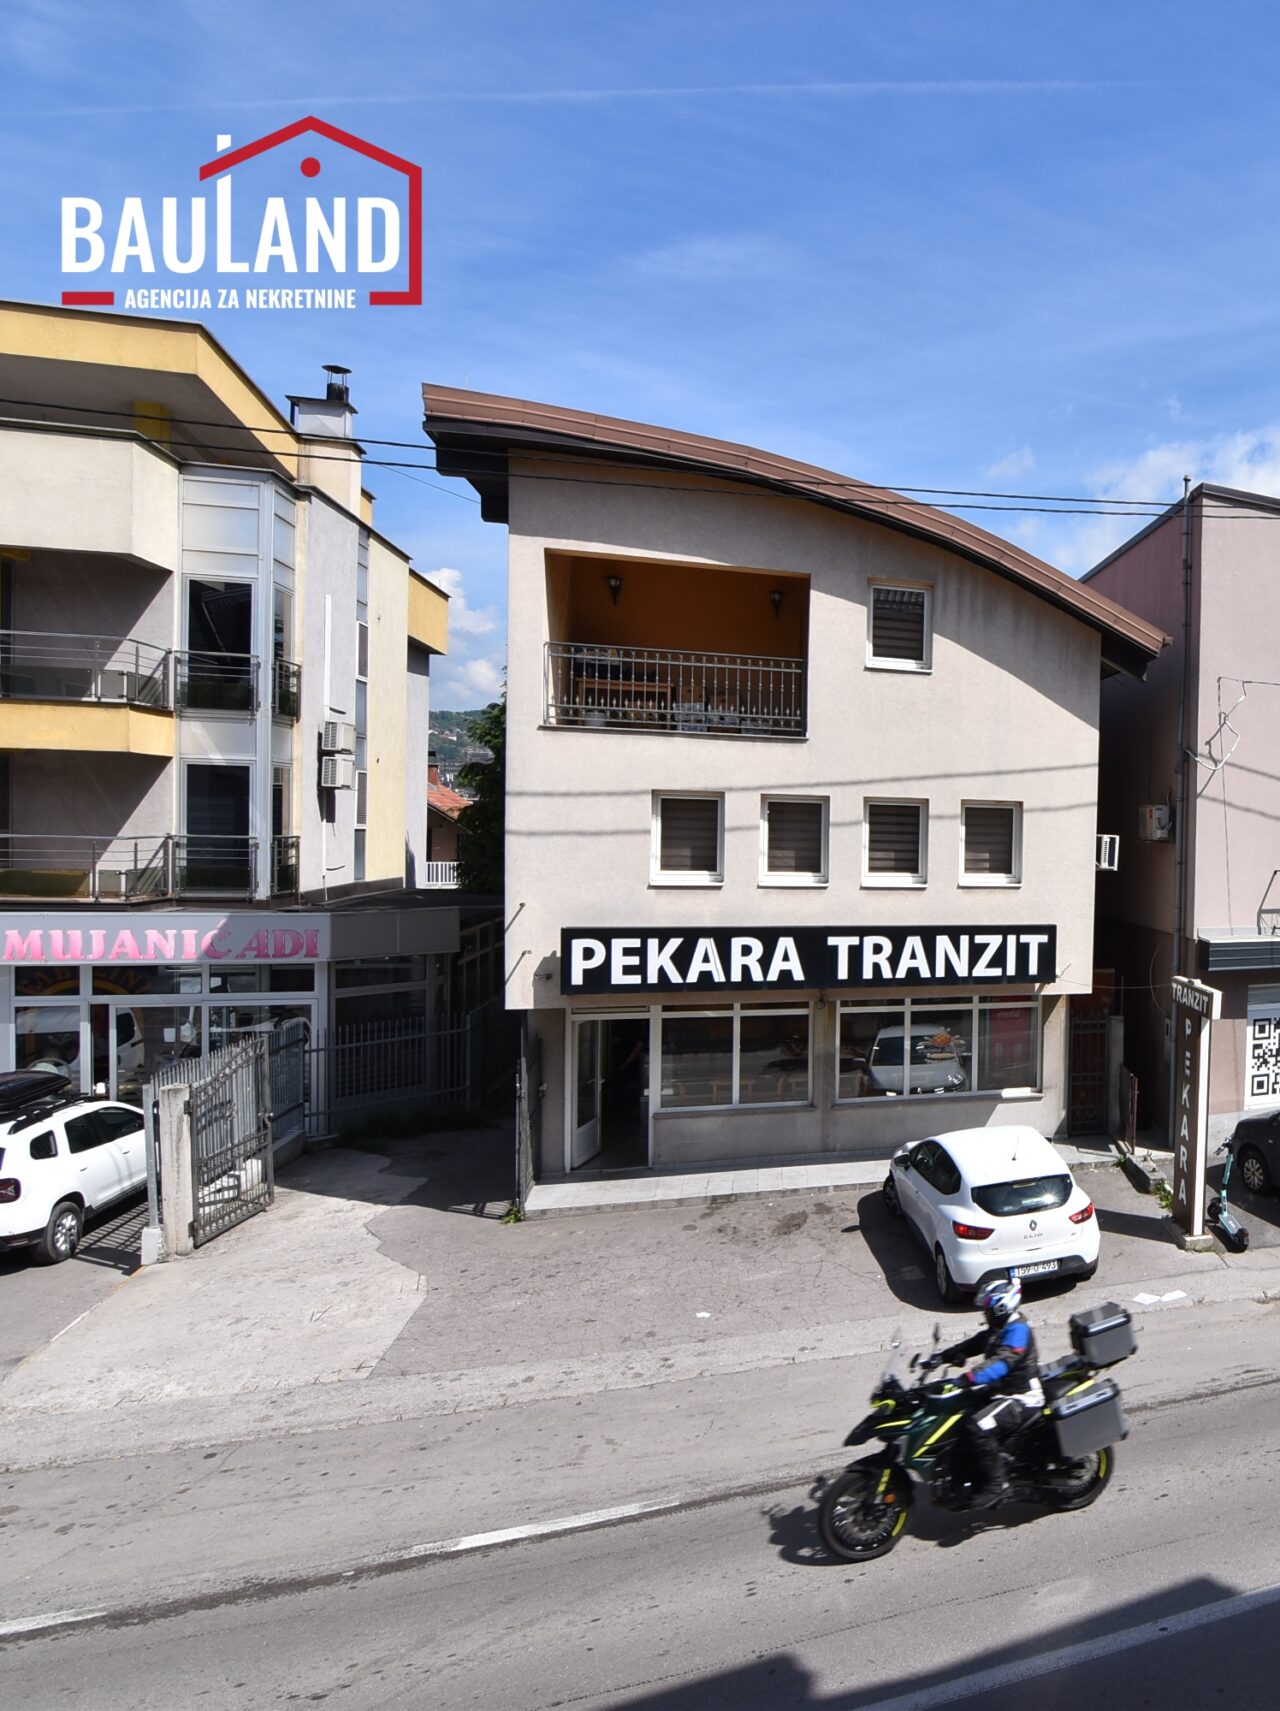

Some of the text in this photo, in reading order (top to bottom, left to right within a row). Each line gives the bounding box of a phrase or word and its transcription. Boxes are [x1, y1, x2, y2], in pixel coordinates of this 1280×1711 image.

[236, 929, 320, 958] ADI
[571, 934, 1049, 986] PEKARA TRANZIT
[1172, 982, 1209, 1014] TRANZIT
[1178, 1018, 1192, 1206] PEKARA
